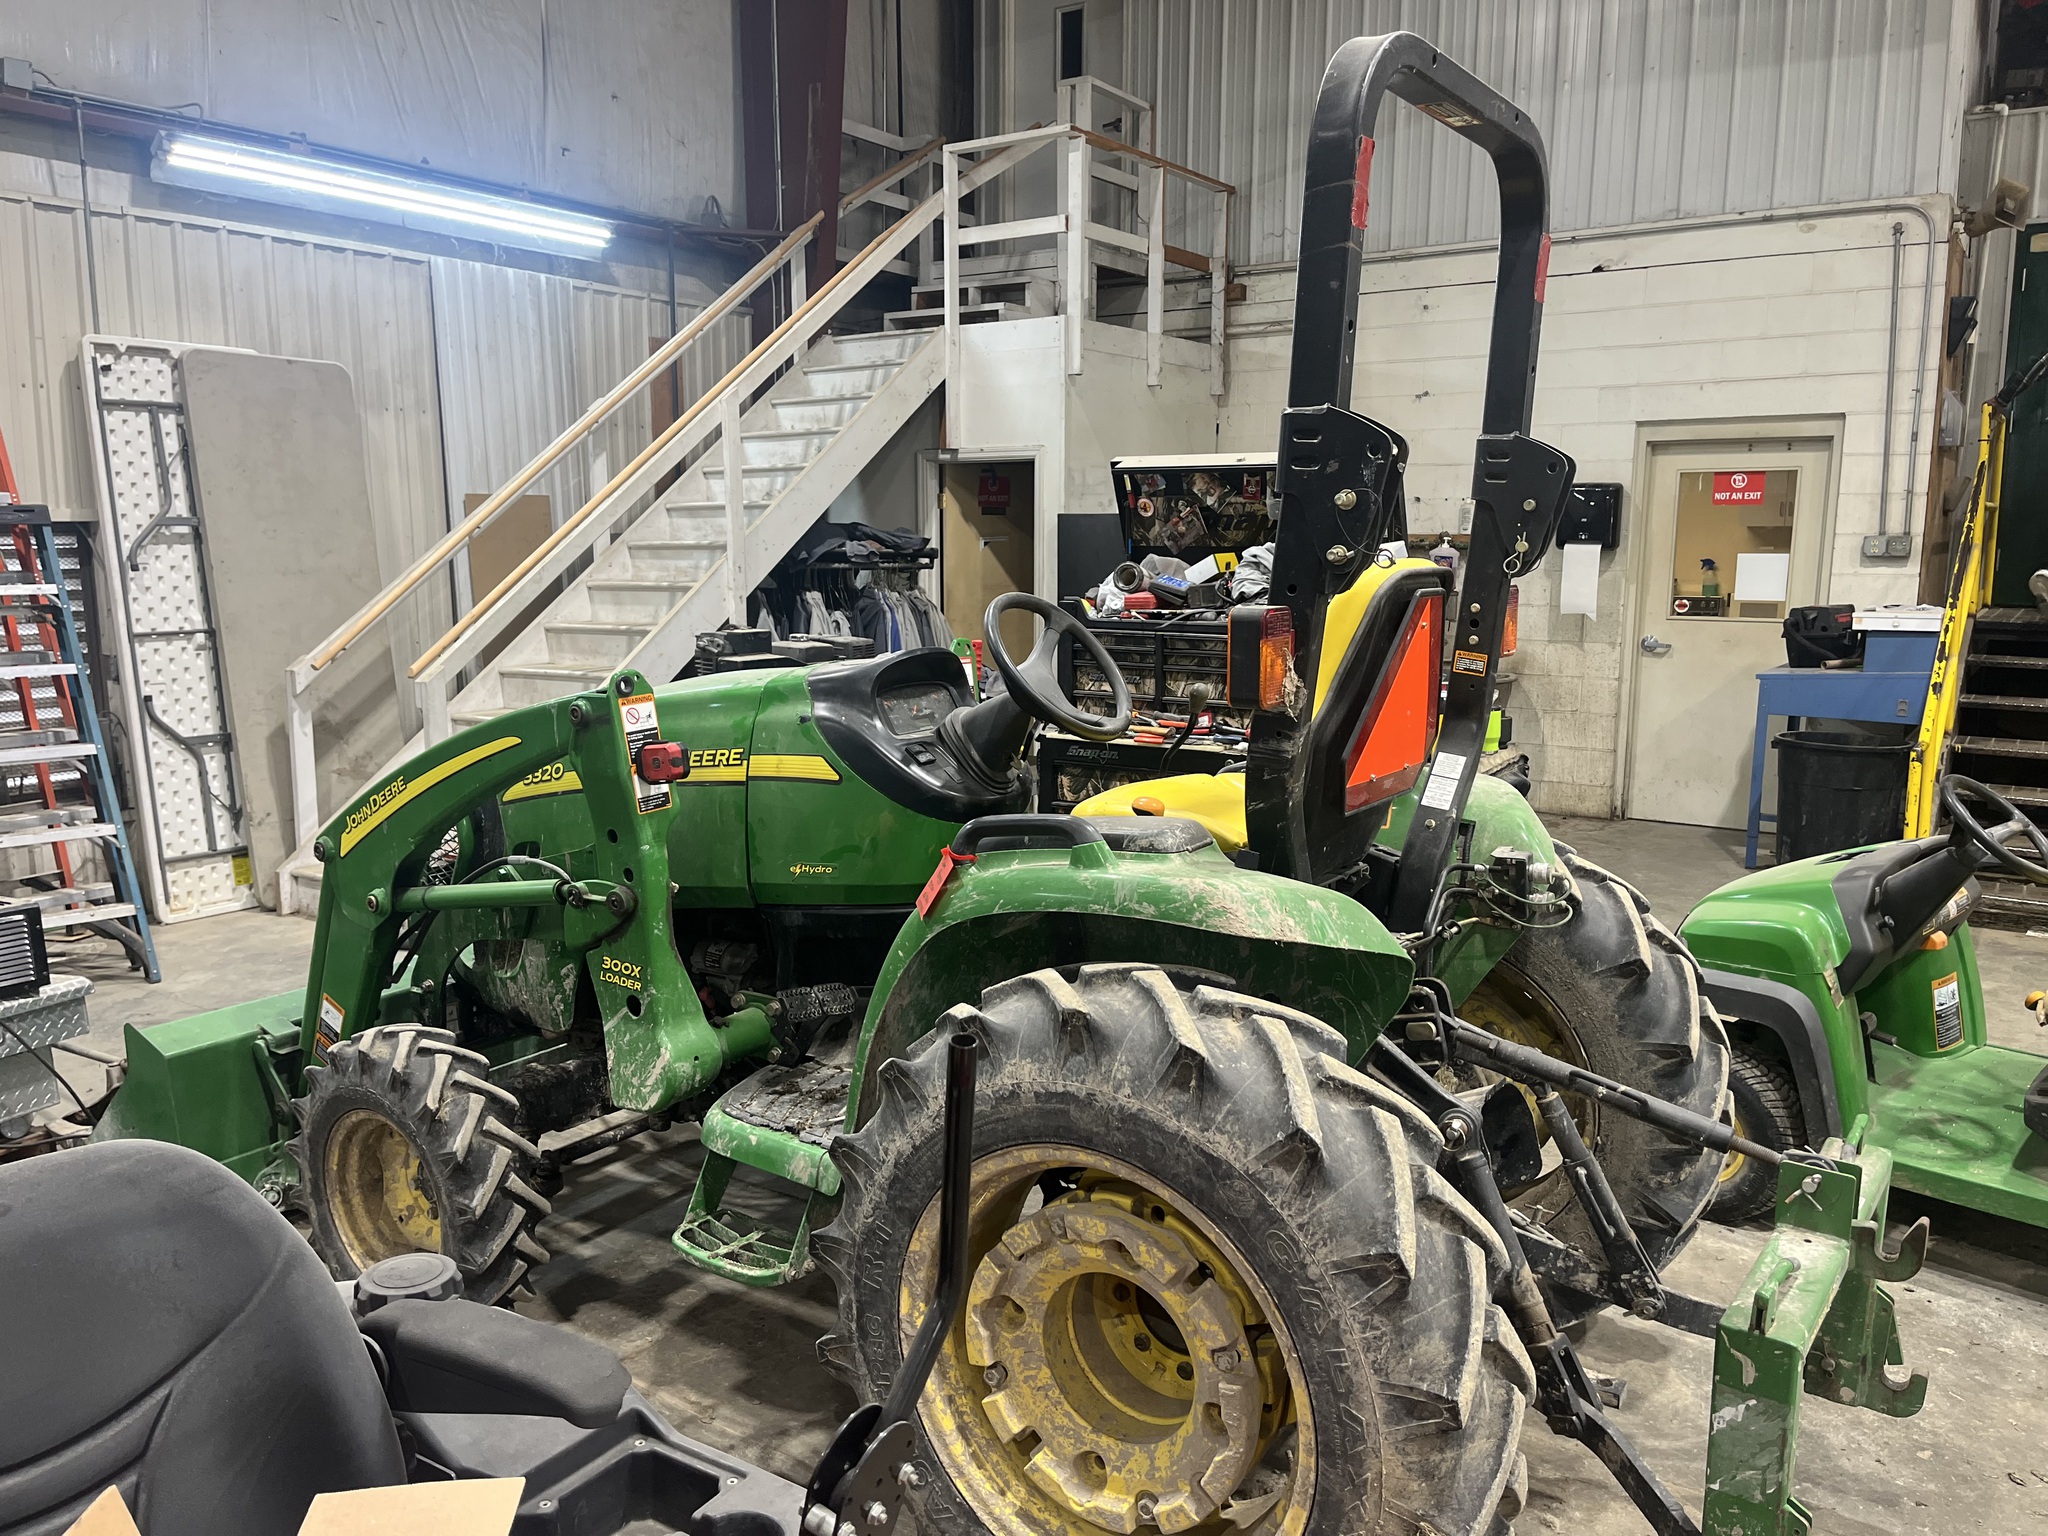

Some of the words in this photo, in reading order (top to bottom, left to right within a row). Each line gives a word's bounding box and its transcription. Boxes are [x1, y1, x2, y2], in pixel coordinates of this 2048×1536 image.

[1714, 492, 1731, 500] NOT
[1731, 492, 1743, 500] AN
[1744, 491, 1762, 500] EXIT
[1462, 652, 1487, 661] WARNING
[625, 694, 653, 705] WARNING
[688, 747, 745, 767] EERE
[344, 803, 372, 834] JOHN
[369, 776, 407, 812] DEERE
[601, 955, 642, 979] 300X
[600, 970, 642, 991] LOADER
